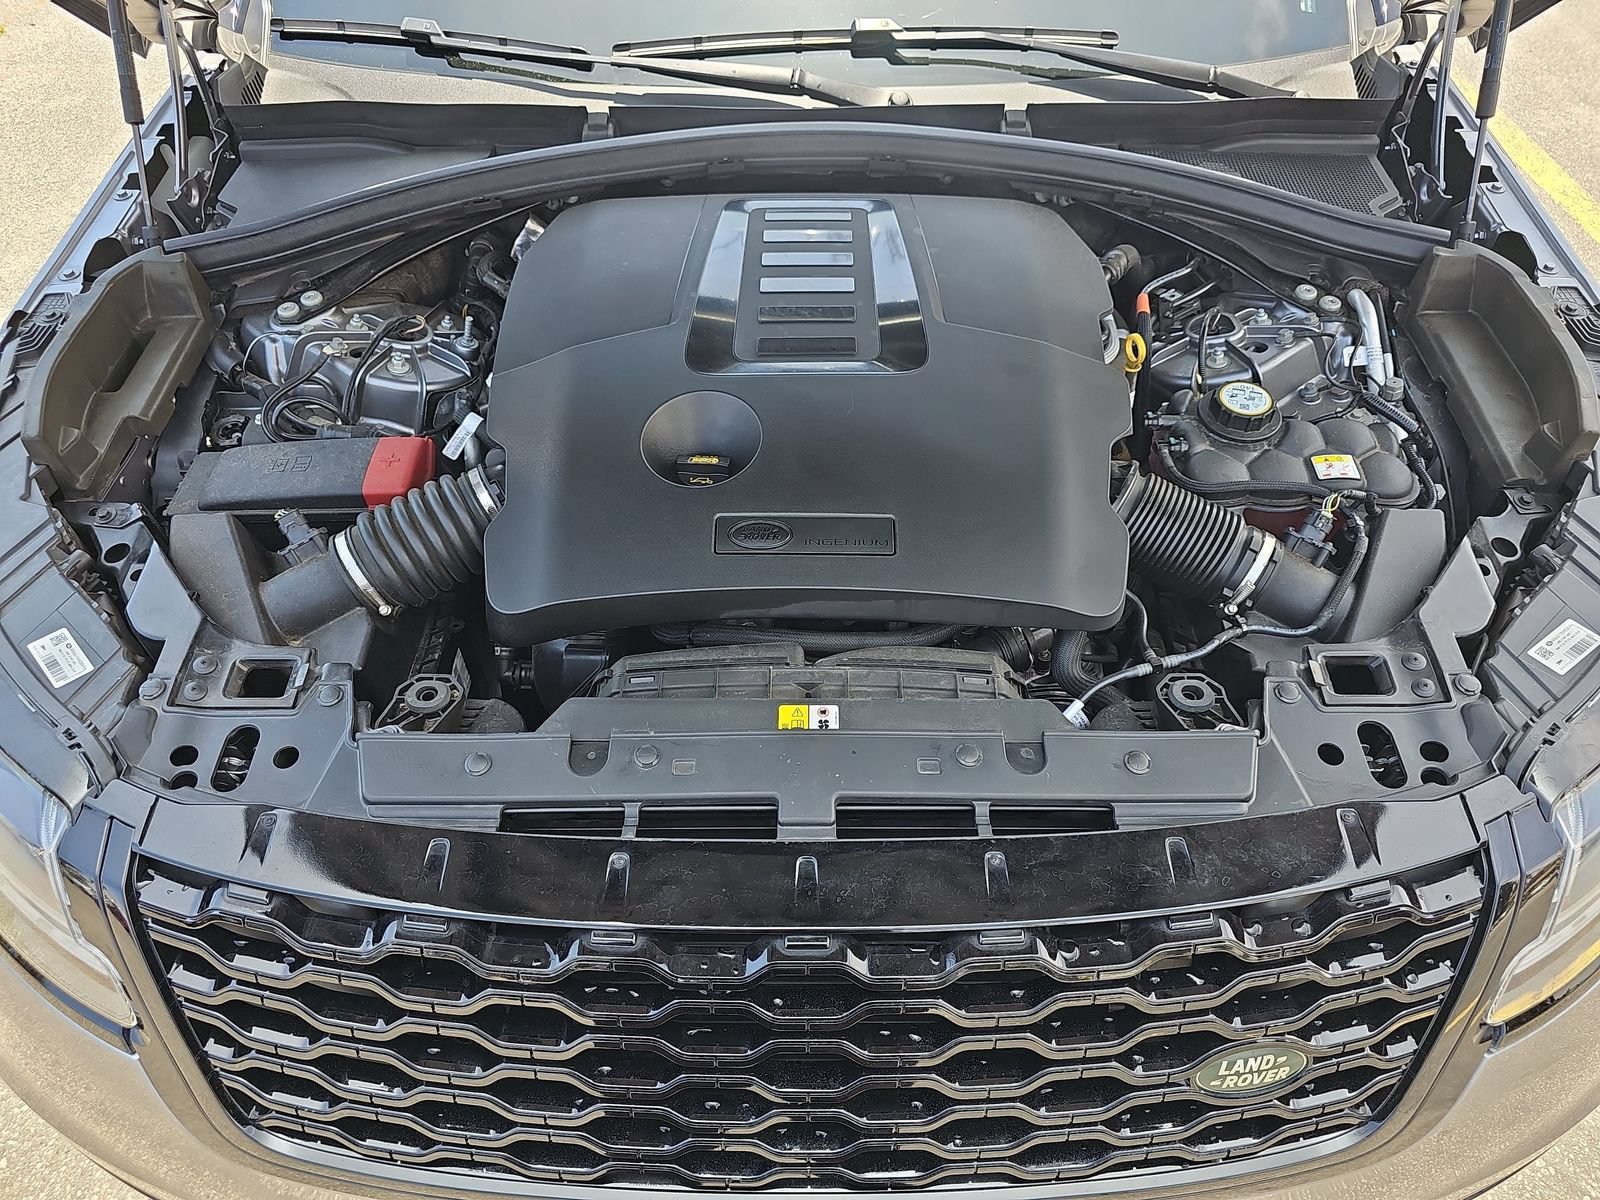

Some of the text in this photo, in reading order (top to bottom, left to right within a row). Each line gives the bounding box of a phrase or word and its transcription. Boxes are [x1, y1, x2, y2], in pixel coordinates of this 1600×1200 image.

[741, 525, 774, 534] LAND
[744, 534, 782, 542] ROVER
[804, 538, 889, 547] INGENIUM
[1218, 1054, 1275, 1076] LAND
[1221, 1066, 1291, 1088] ROVER
